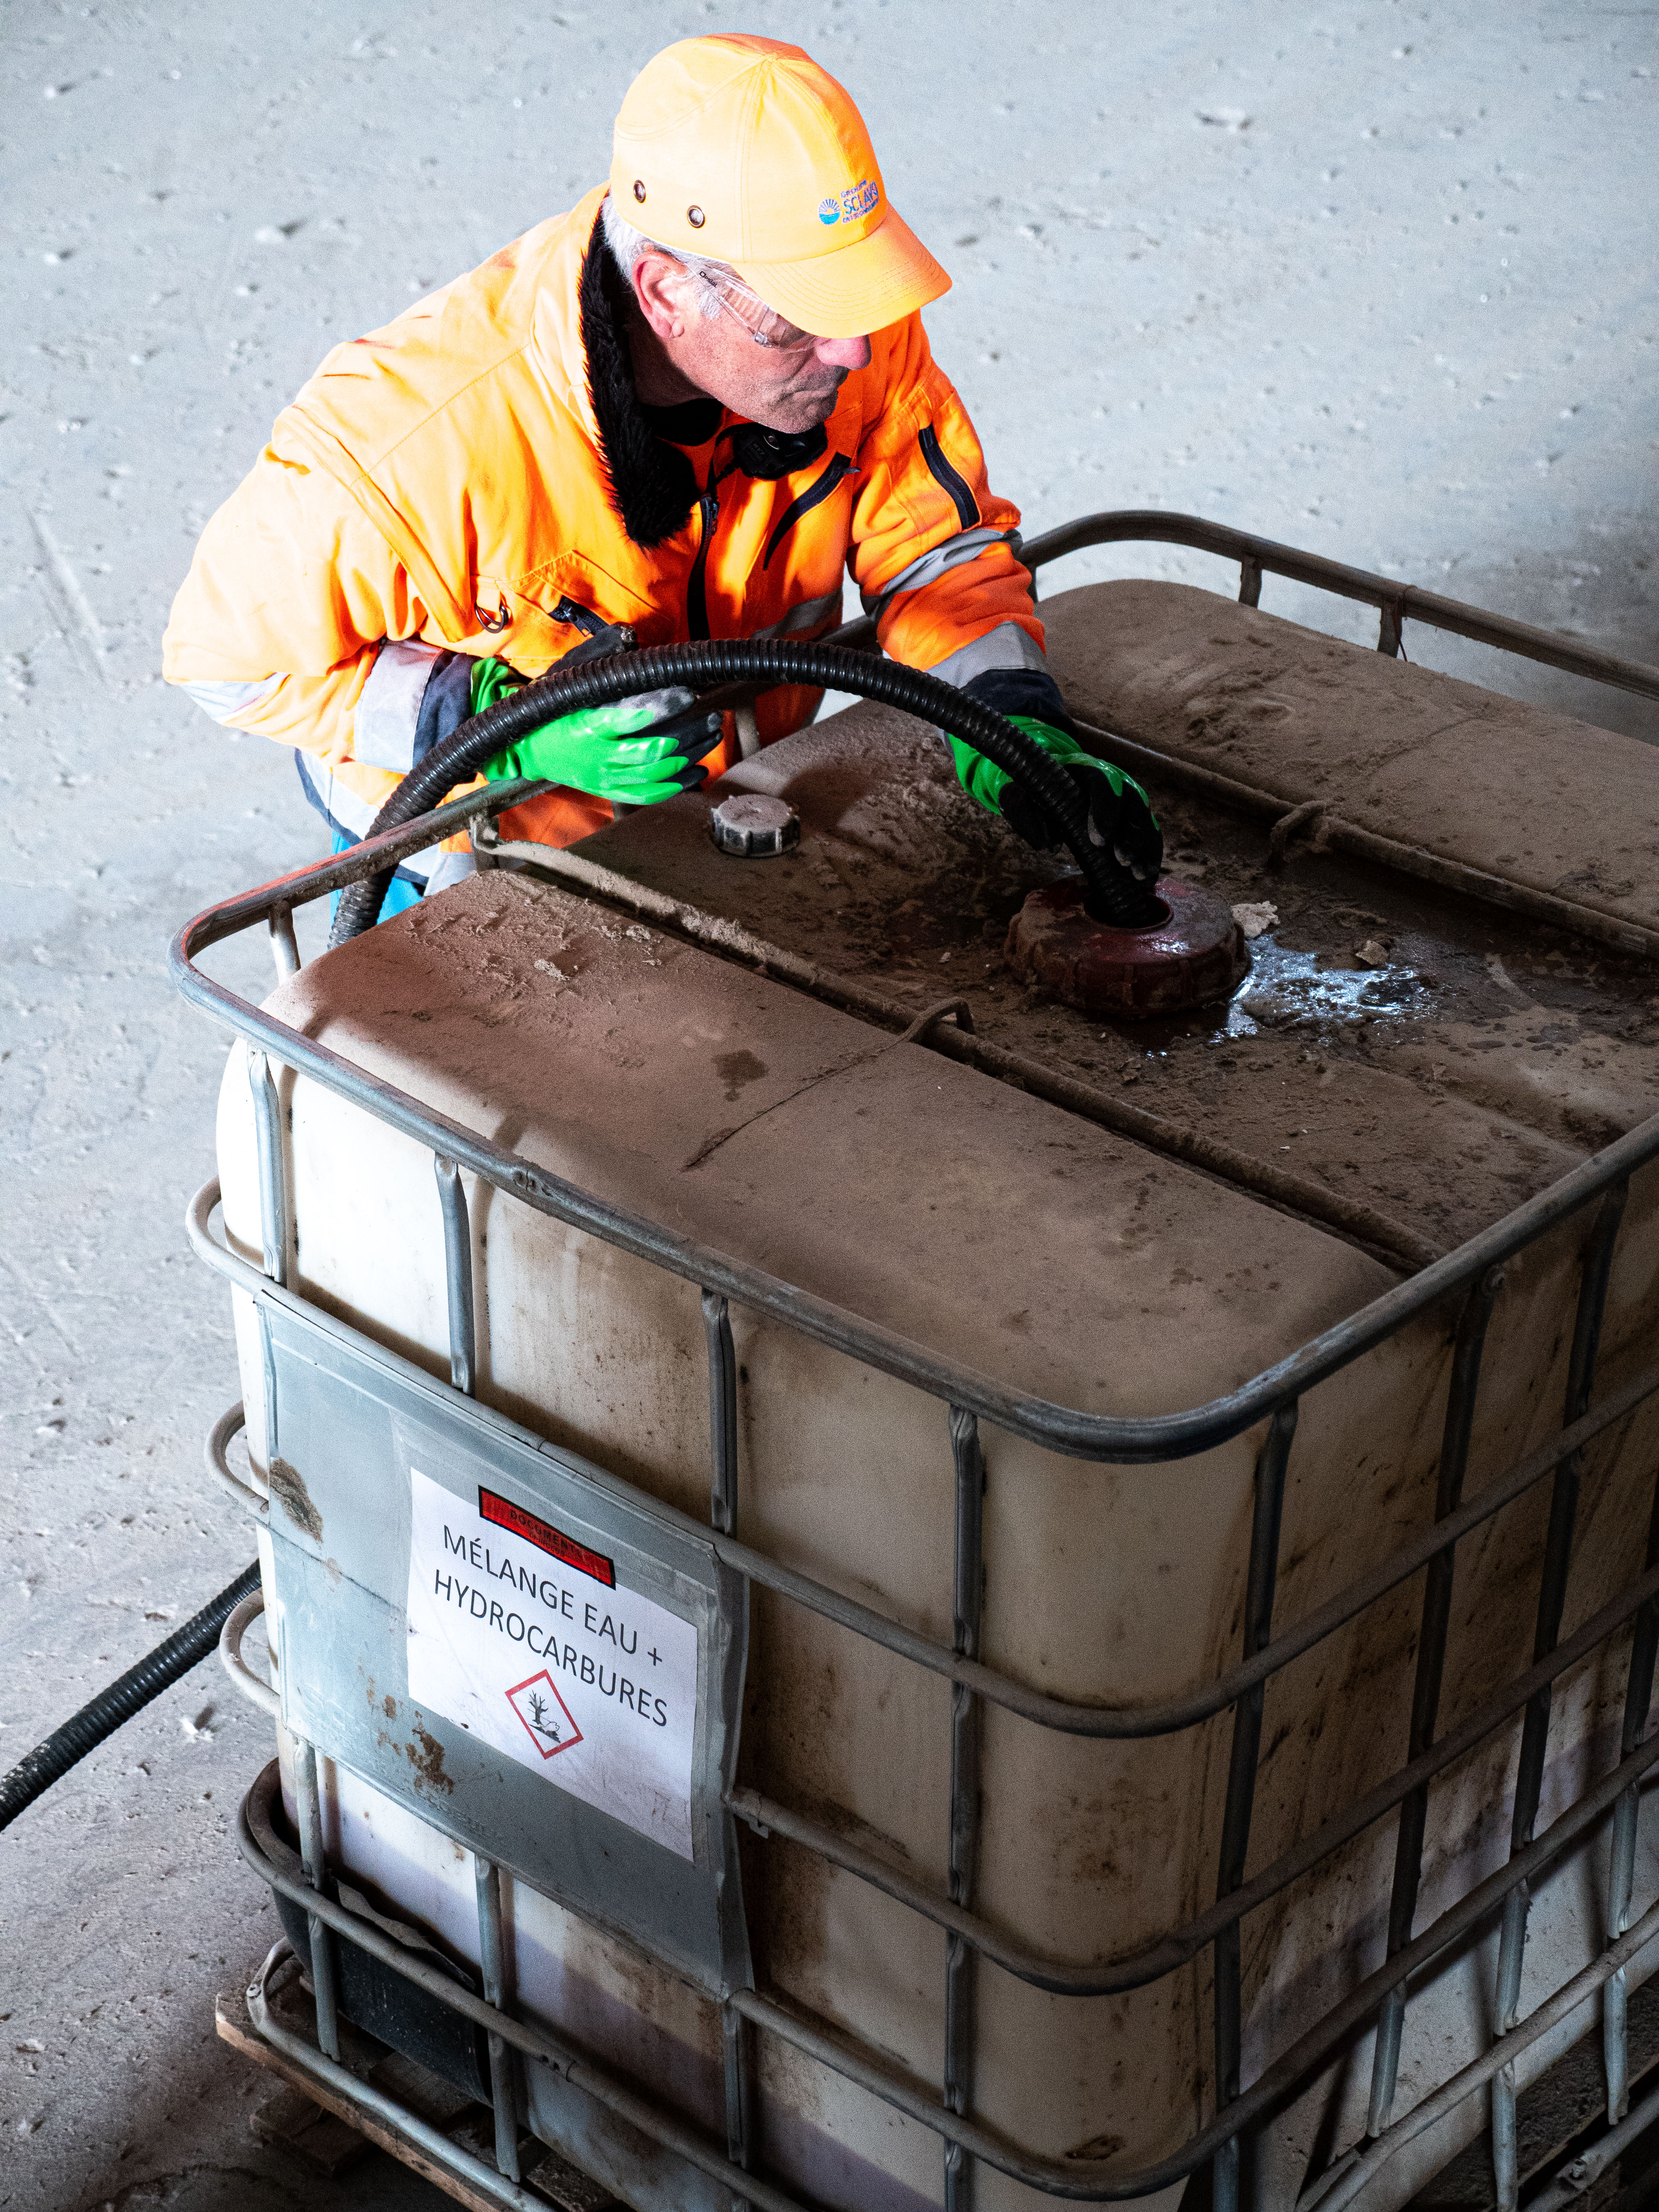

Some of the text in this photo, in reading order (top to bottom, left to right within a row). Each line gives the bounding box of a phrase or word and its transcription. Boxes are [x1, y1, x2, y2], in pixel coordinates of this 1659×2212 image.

[843, 181, 879, 214] SCLAVO
[510, 1509, 583, 1558] DOCUMENTS
[444, 1525, 663, 1666] MÉLANGE EAU +
[435, 1569, 667, 1726] HYDROCARBURES
